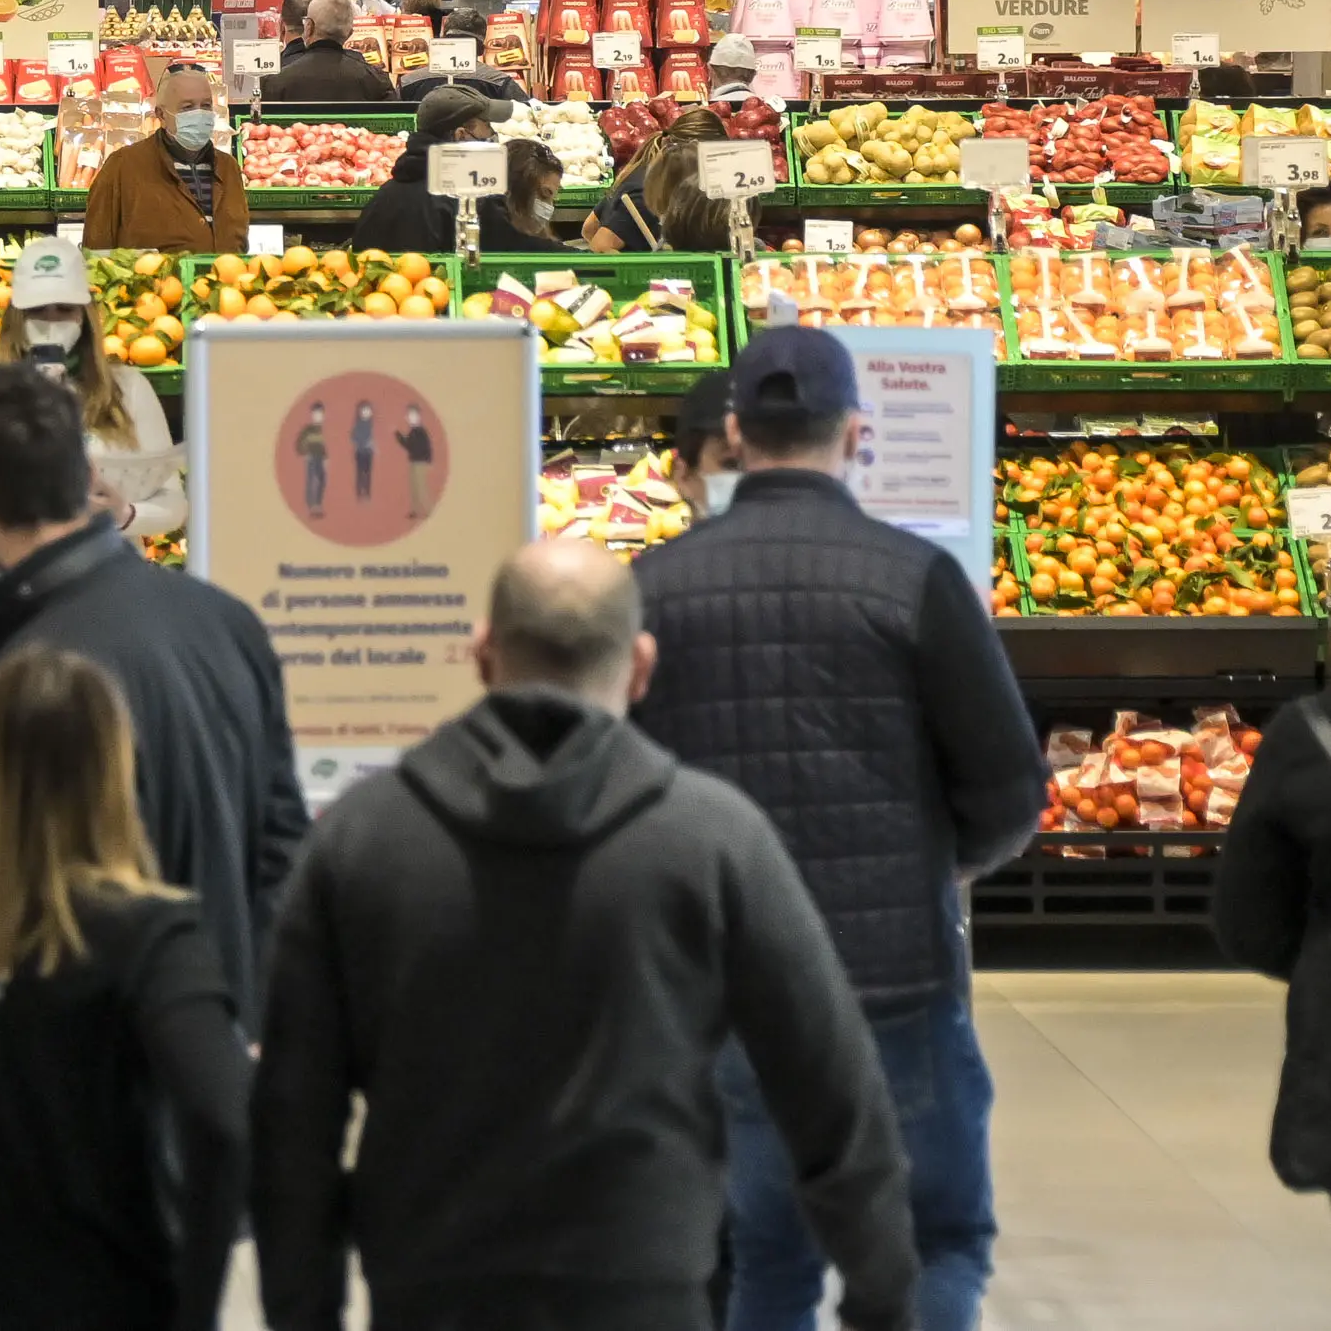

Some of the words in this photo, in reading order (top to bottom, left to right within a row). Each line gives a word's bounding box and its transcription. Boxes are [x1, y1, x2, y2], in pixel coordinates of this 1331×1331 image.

[995, 0, 1089, 16] VERDURE
[254, 57, 275, 69] 1,89
[449, 56, 470, 69] 1,49
[613, 49, 633, 63] 2,19
[815, 54, 835, 67] 1,95
[997, 53, 1020, 65] 2,00
[1192, 49, 1214, 63] 1,46
[68, 58, 88, 71] 1,49
[468, 169, 497, 187] 1,99
[1286, 163, 1319, 182] 3,98
[733, 172, 766, 188] 2,49
[826, 238, 846, 252] 1,29
[898, 361, 946, 375] Vostra
[360, 559, 449, 578] massimo
[285, 593, 366, 612] persone
[372, 593, 466, 608] ammesse
[269, 620, 472, 640] ontemporaneamente
[331, 647, 362, 664] del
[367, 646, 426, 665] locale
